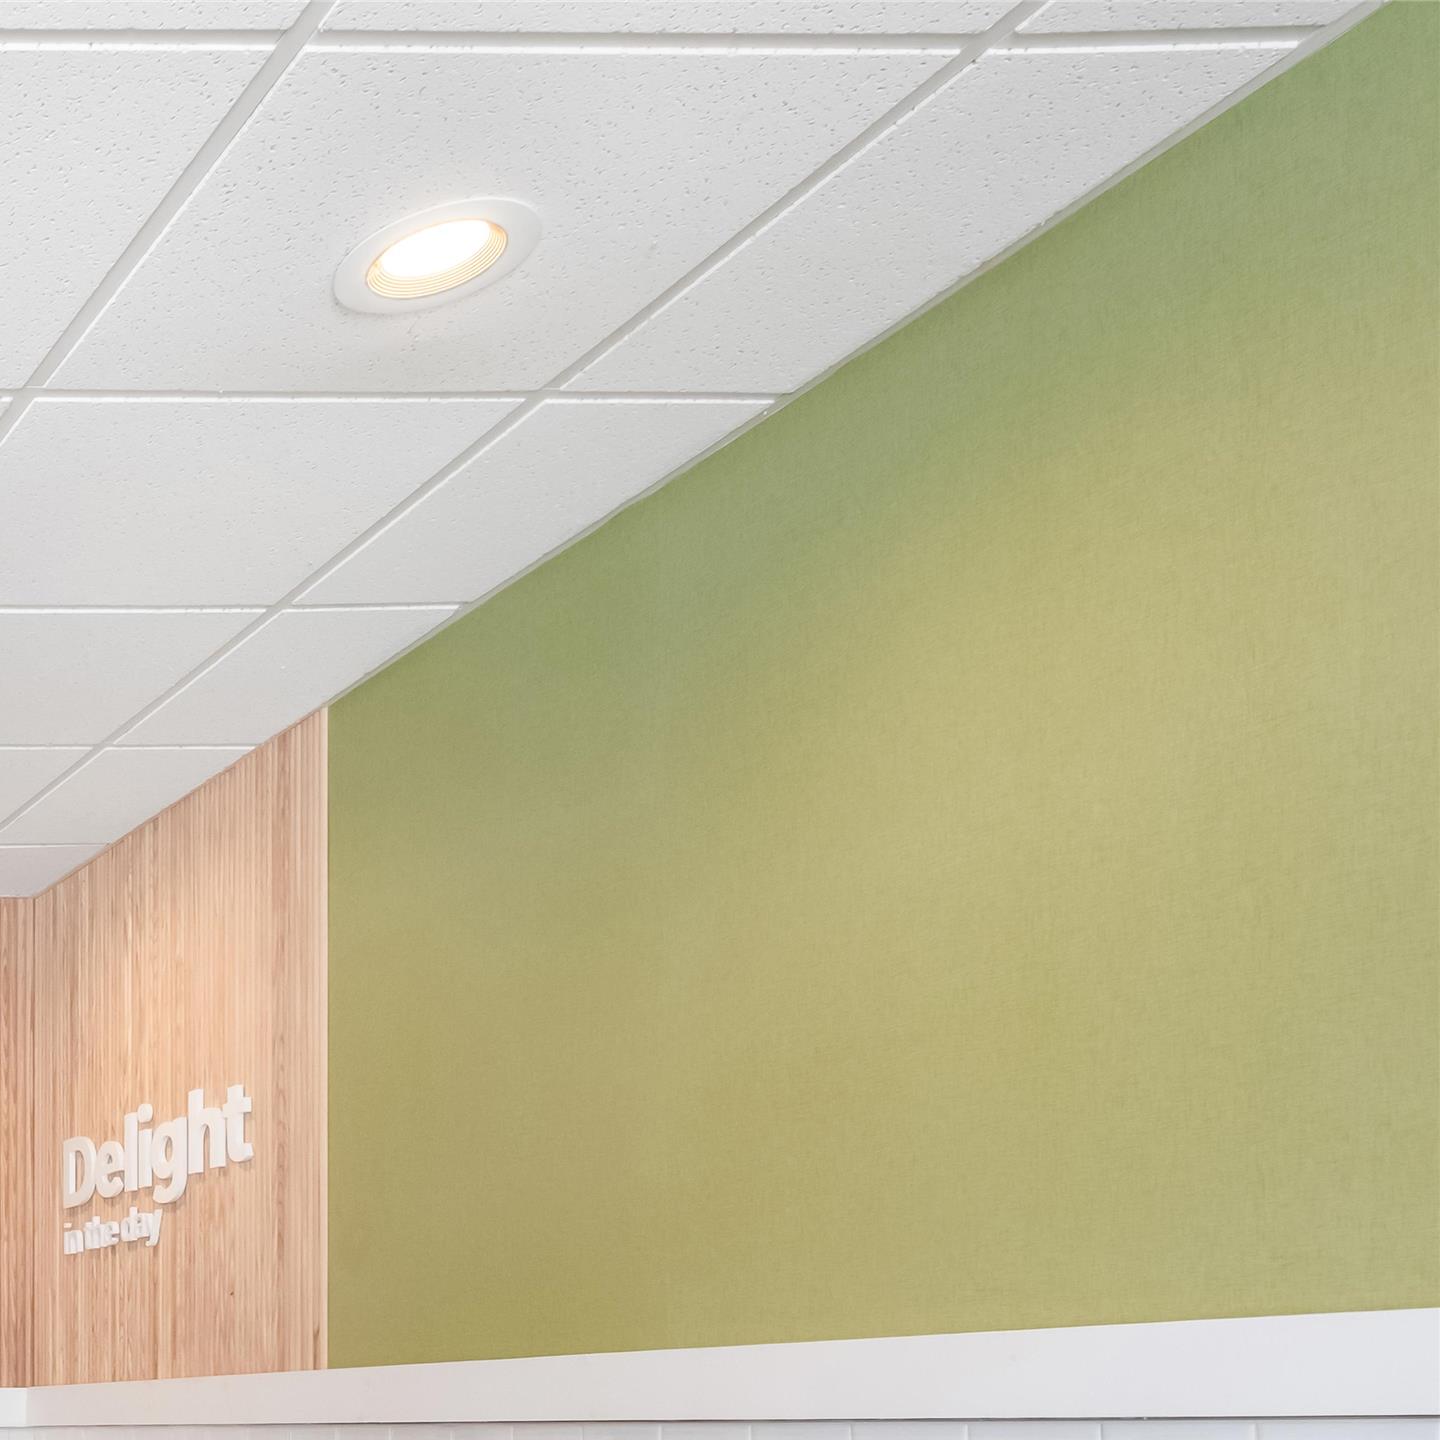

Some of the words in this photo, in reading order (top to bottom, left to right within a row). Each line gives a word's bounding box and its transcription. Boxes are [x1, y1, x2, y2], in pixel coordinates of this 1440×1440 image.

[63, 1083, 254, 1209] Delight
[63, 1222, 84, 1255] in
[84, 1215, 120, 1249] the
[120, 1206, 163, 1247] day
